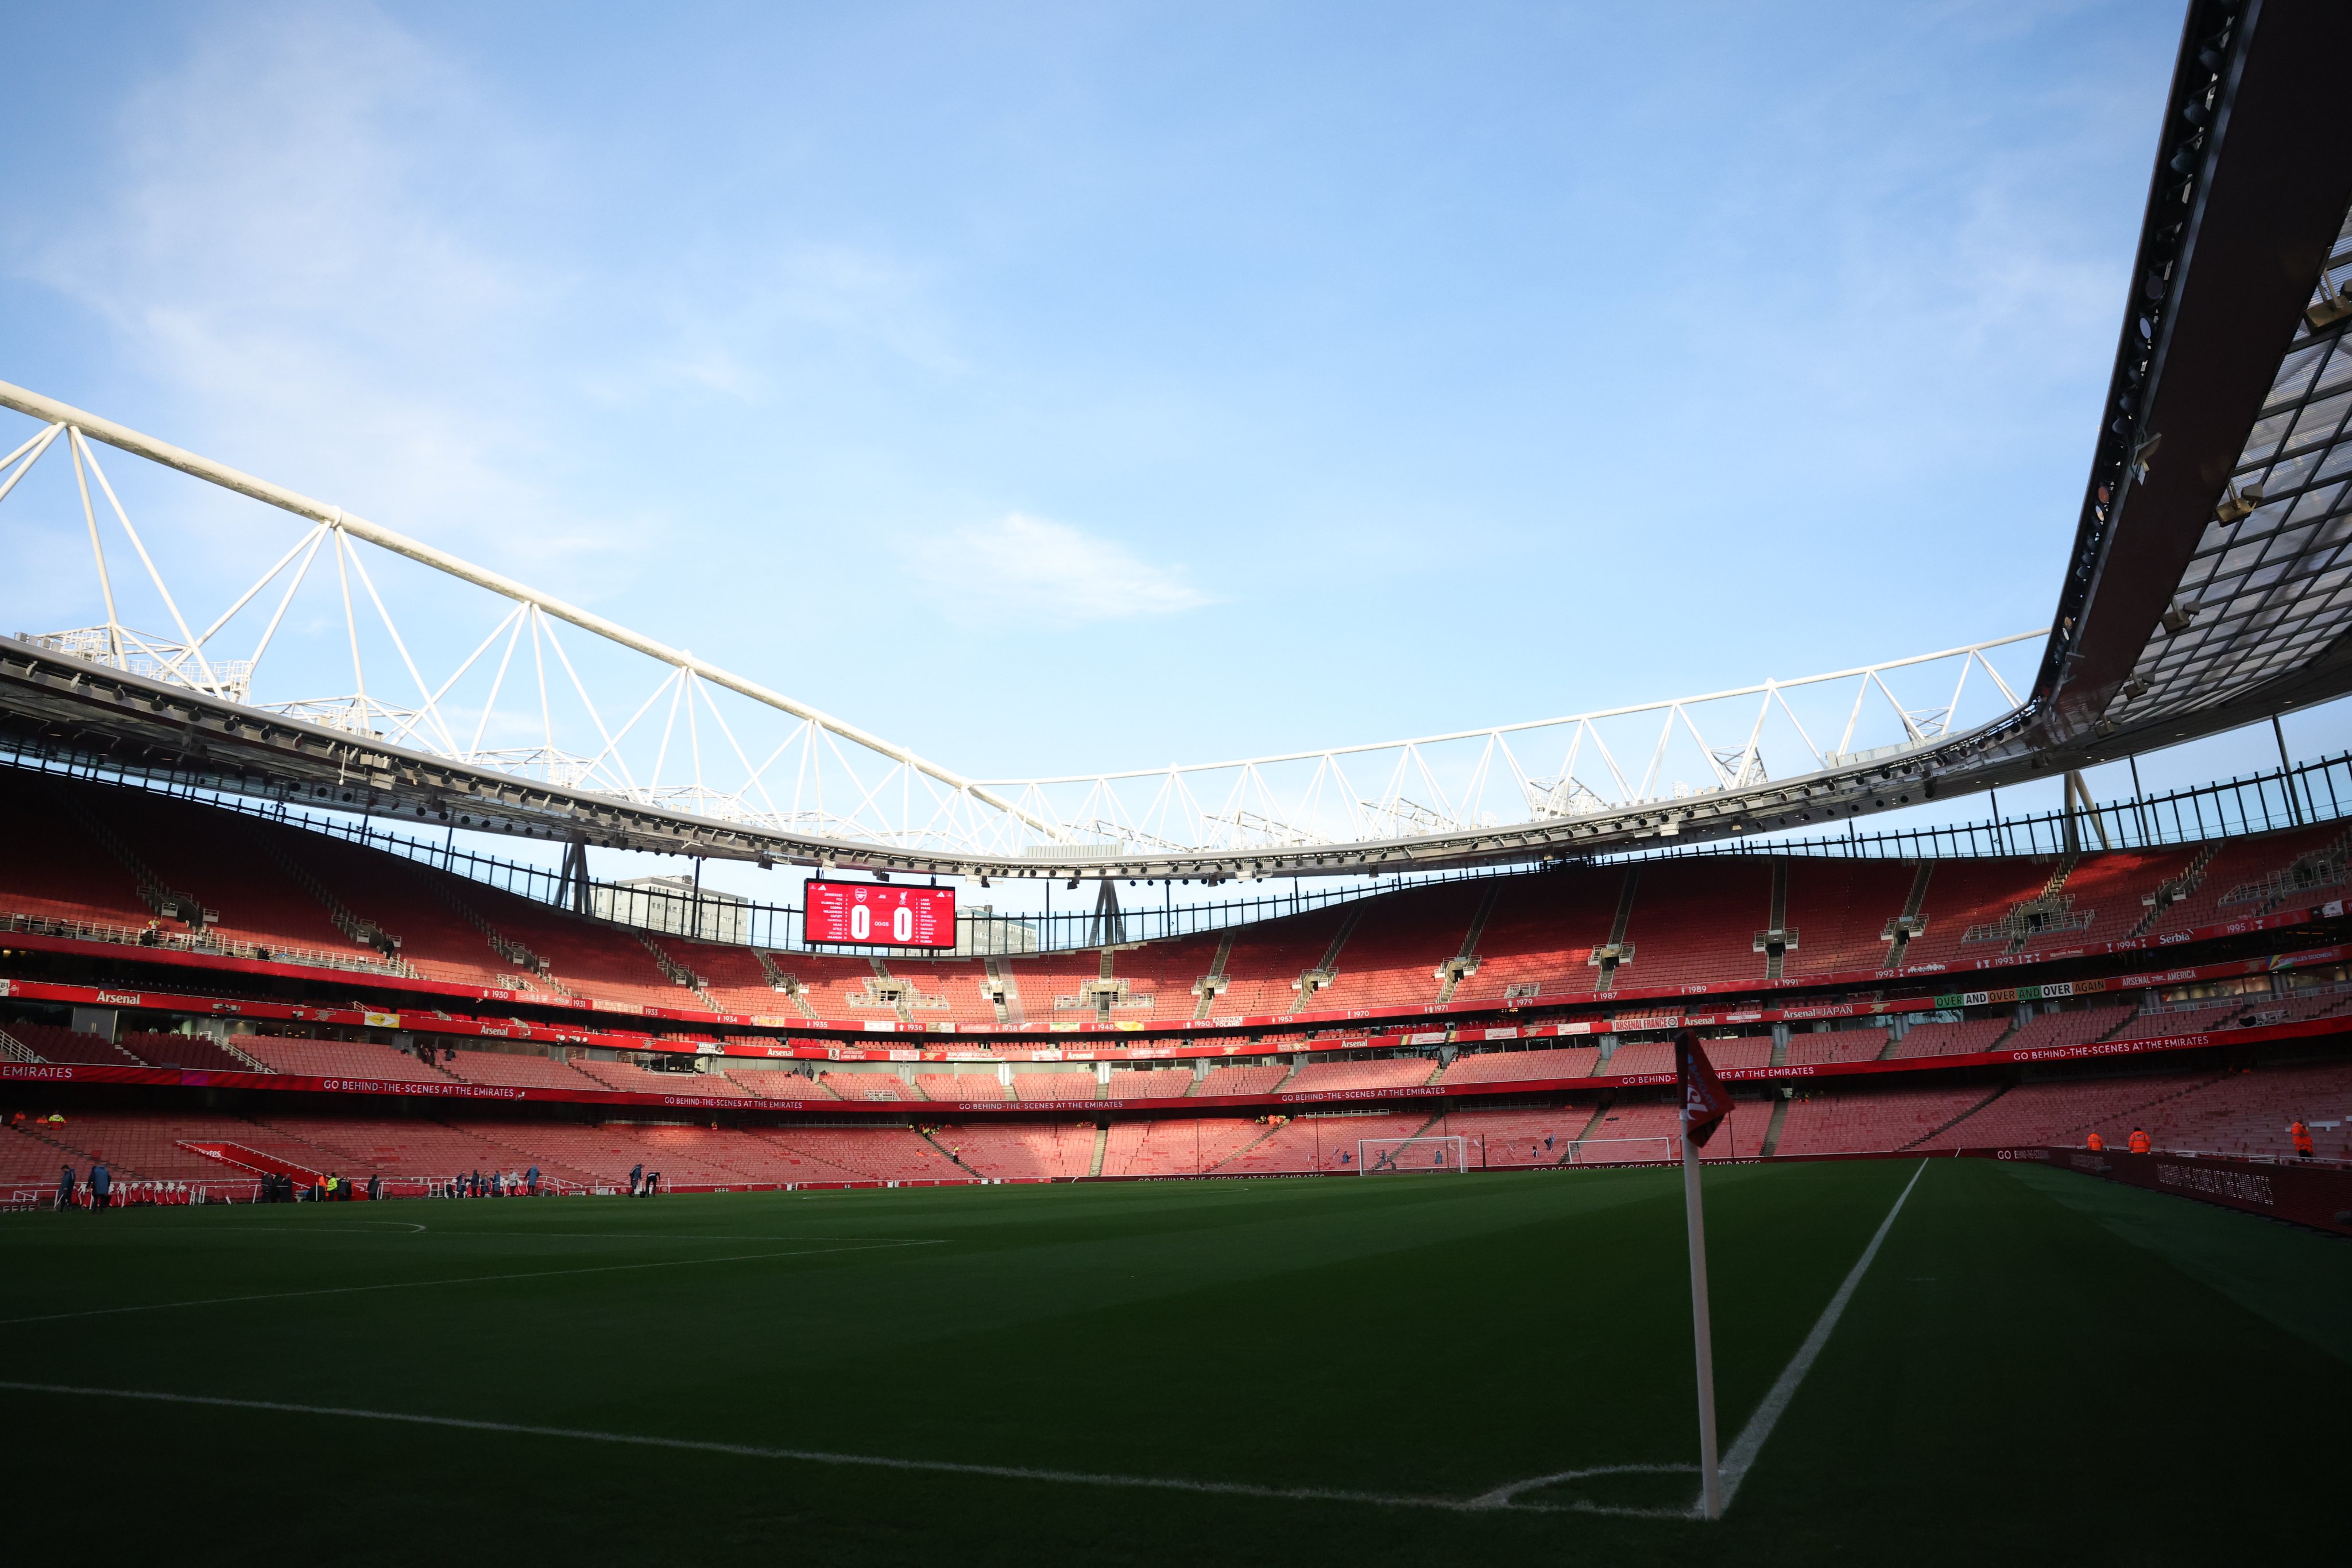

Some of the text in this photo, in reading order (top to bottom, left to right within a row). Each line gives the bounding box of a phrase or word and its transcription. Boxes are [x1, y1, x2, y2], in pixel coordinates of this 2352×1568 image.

[851, 905, 870, 939] 0
[893, 907, 912, 941] 0
[2227, 923, 2246, 933] 1995
[2160, 932, 2189, 944] Serbia
[2117, 940, 2136, 950] 1994
[1995, 957, 2014, 965] 1993
[2122, 970, 2196, 986] ARSENAL AMERICA
[96, 991, 140, 1005] Arsenal
[492, 990, 508, 999] 1930
[1937, 980, 2104, 1006] OVER AND OVER AND OVER AGAIN
[573, 1000, 585, 1008] 1931
[1784, 1005, 1852, 1019] Arsenal JAPAN
[1616, 1019, 1667, 1031] ARSENAL FRANCE
[1684, 1016, 1715, 1025] Arsenal
[481, 1025, 508, 1036] Arsenal
[1341, 1039, 1368, 1048] Arsenal
[2014, 1036, 2209, 1060] GO BEHIND-THE-SCENES AT THE EMIRATES
[767, 1048, 794, 1056] Arsenal
[1067, 1051, 1094, 1059] Arsenal
[3, 1066, 72, 1078] EMIRATES
[1622, 1077, 1635, 1085] GO
[1769, 1067, 1814, 1077] EMIRATES
[324, 1080, 513, 1097] GO BEHIND-THE-SCENES AT THE EMIRATES
[1295, 1091, 1375, 1101] BEHIND-THE-SCENES
[1407, 1087, 1445, 1095] EMIRATES
[676, 1097, 741, 1107] BEHIND-THE-SCENES
[1997, 1150, 2011, 1160] GO
